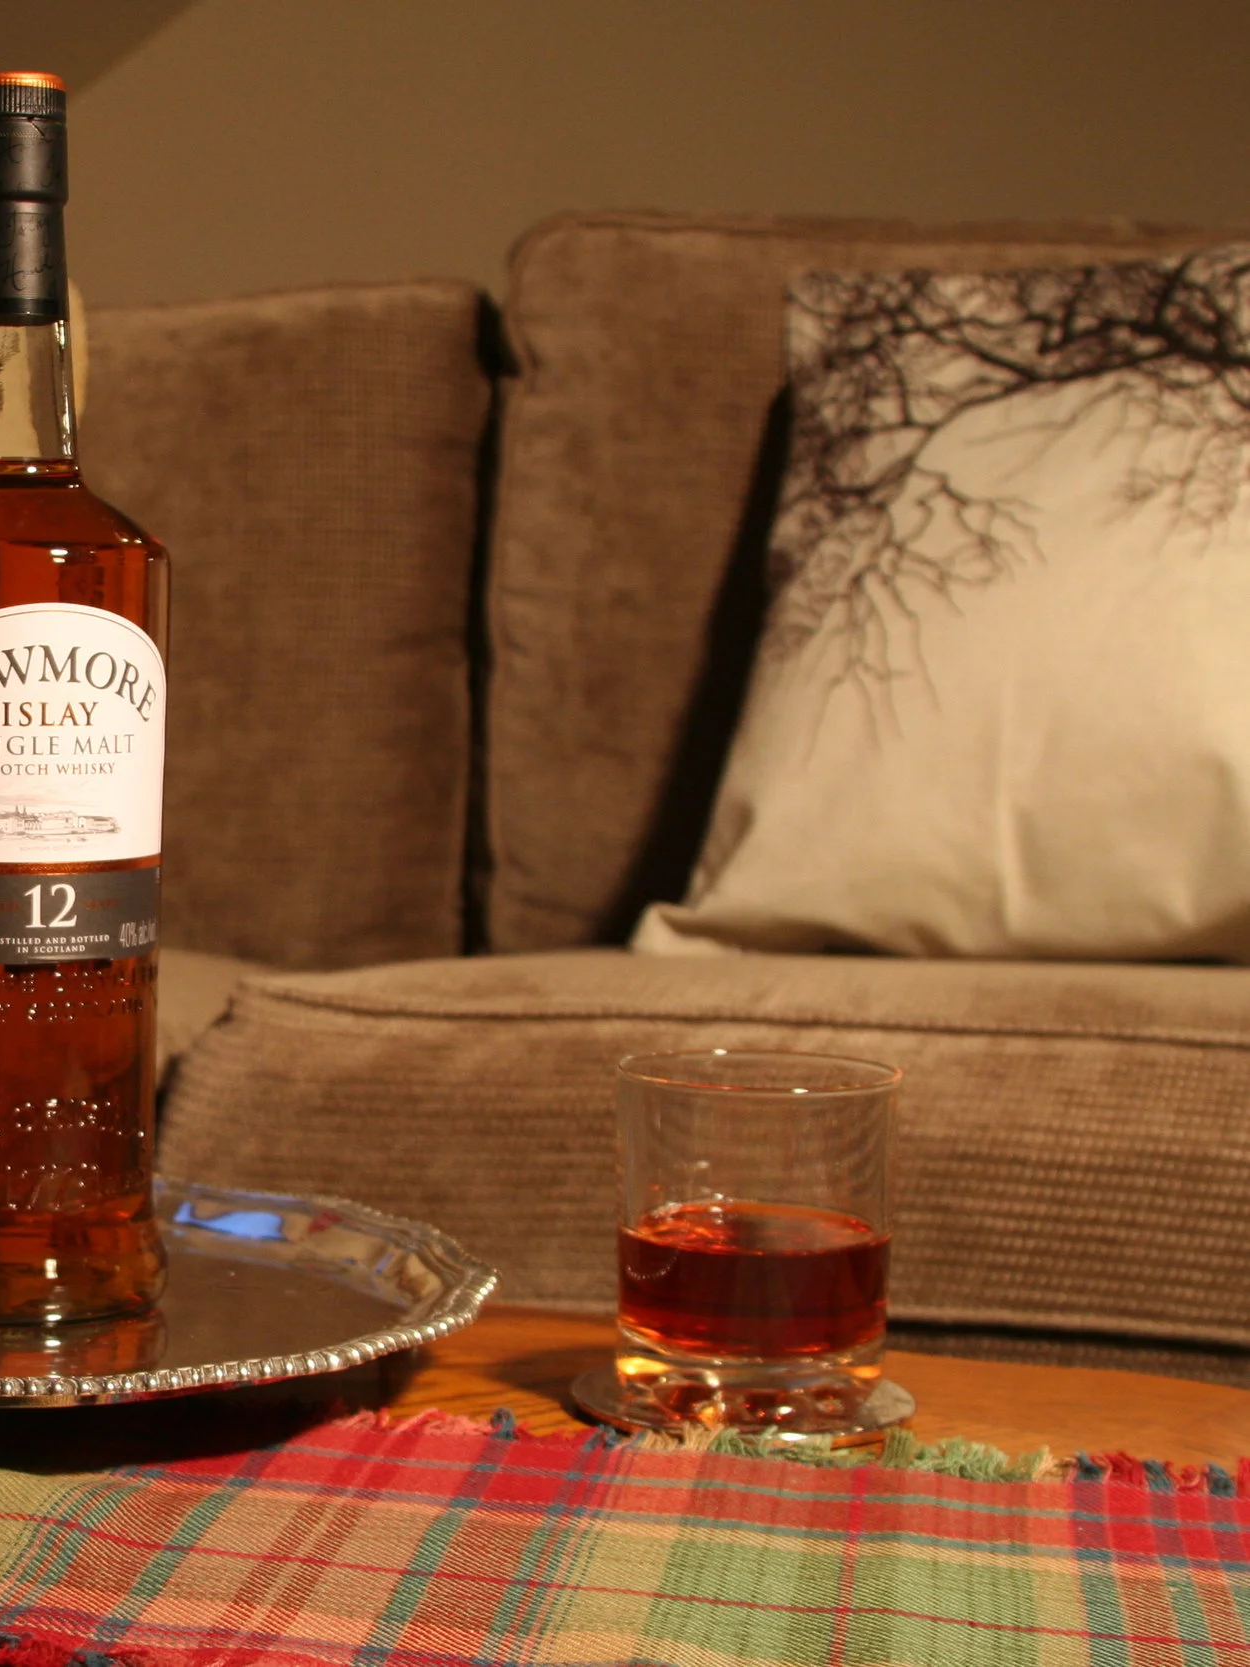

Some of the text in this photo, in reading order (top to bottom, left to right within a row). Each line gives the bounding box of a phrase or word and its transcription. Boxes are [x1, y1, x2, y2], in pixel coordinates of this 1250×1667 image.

[1, 701, 99, 727] ISLAY
[73, 733, 135, 756] MALT
[56, 762, 117, 776] WHISKY
[24, 883, 78, 928] 12
[45, 936, 67, 945] AND
[70, 934, 111, 945] BOTTLED
[17, 944, 86, 954] IN SCOTLAND
